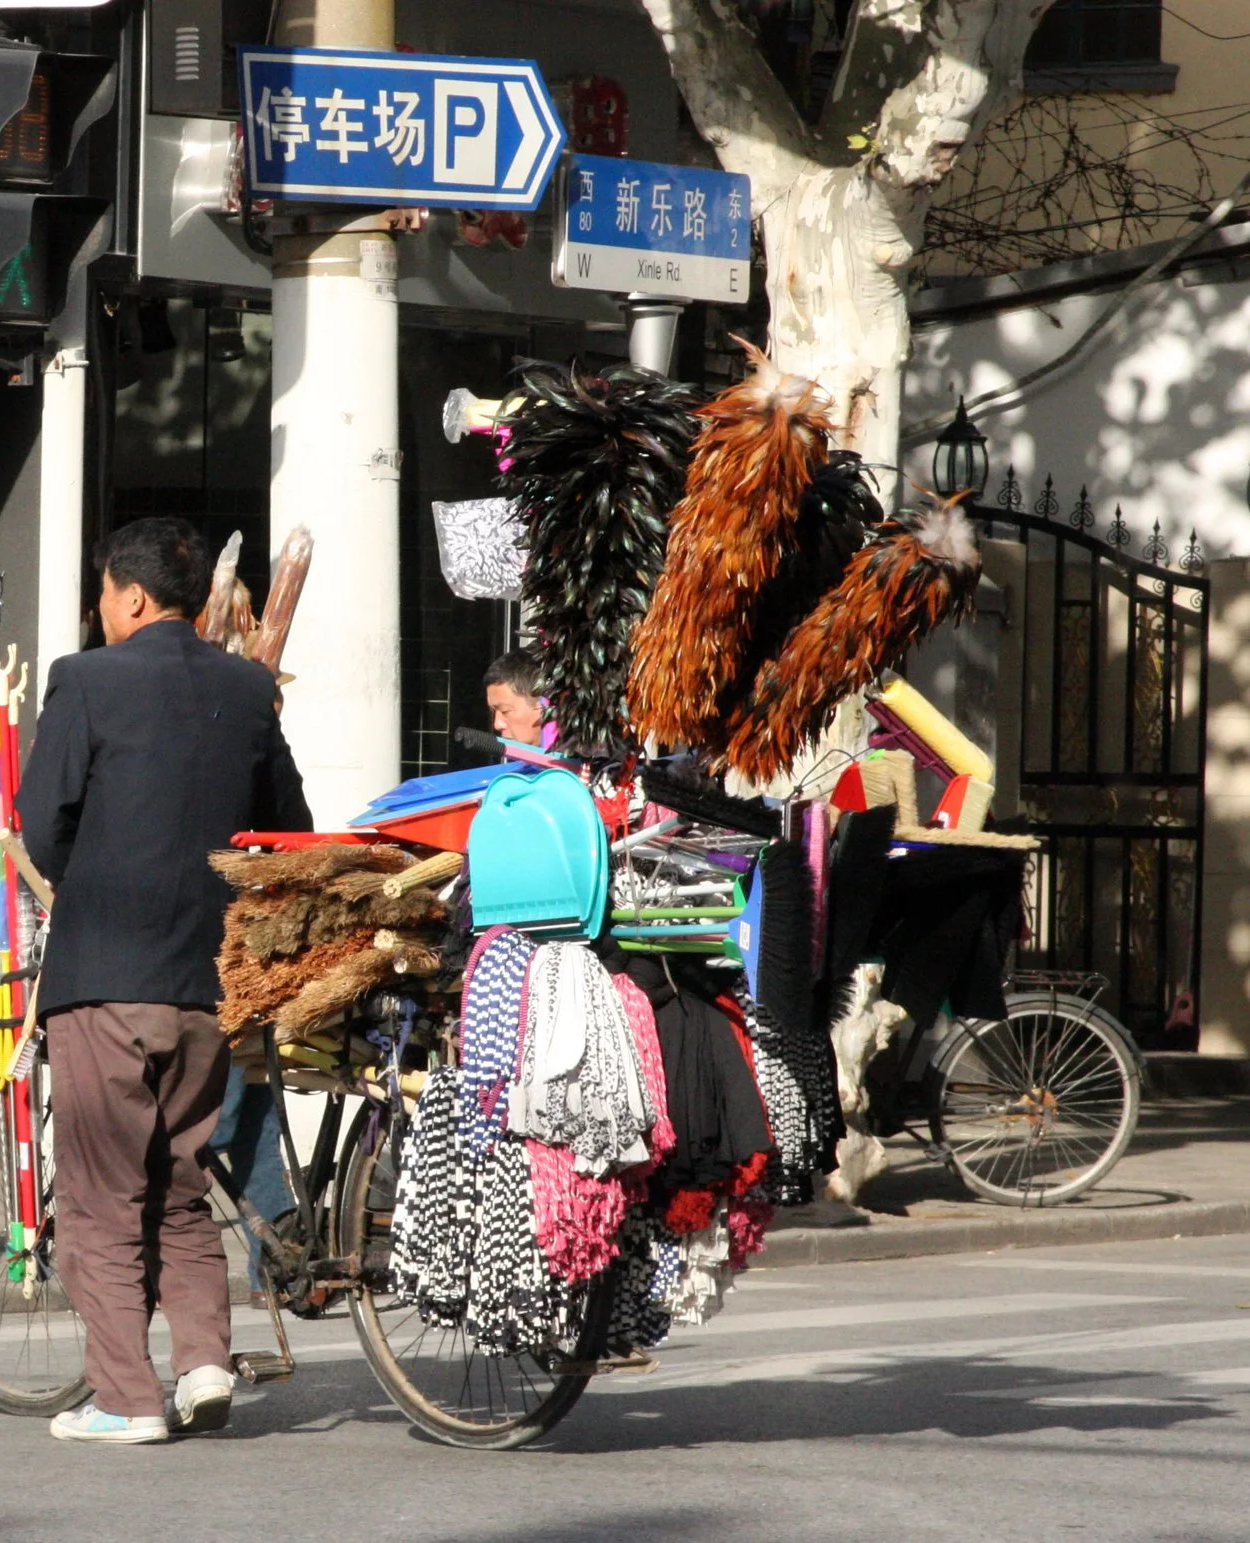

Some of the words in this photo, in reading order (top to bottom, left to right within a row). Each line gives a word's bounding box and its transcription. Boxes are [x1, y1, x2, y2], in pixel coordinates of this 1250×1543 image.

[255, 86, 426, 166] 停车场
[445, 93, 486, 169] P
[579, 170, 595, 203] 西
[616, 177, 707, 241] 新乐路
[729, 188, 742, 220] 东
[579, 211, 592, 231] 80
[730, 228, 738, 248] 2
[577, 253, 592, 278] W
[637, 259, 662, 281] Xinle
[729, 268, 738, 293] E
